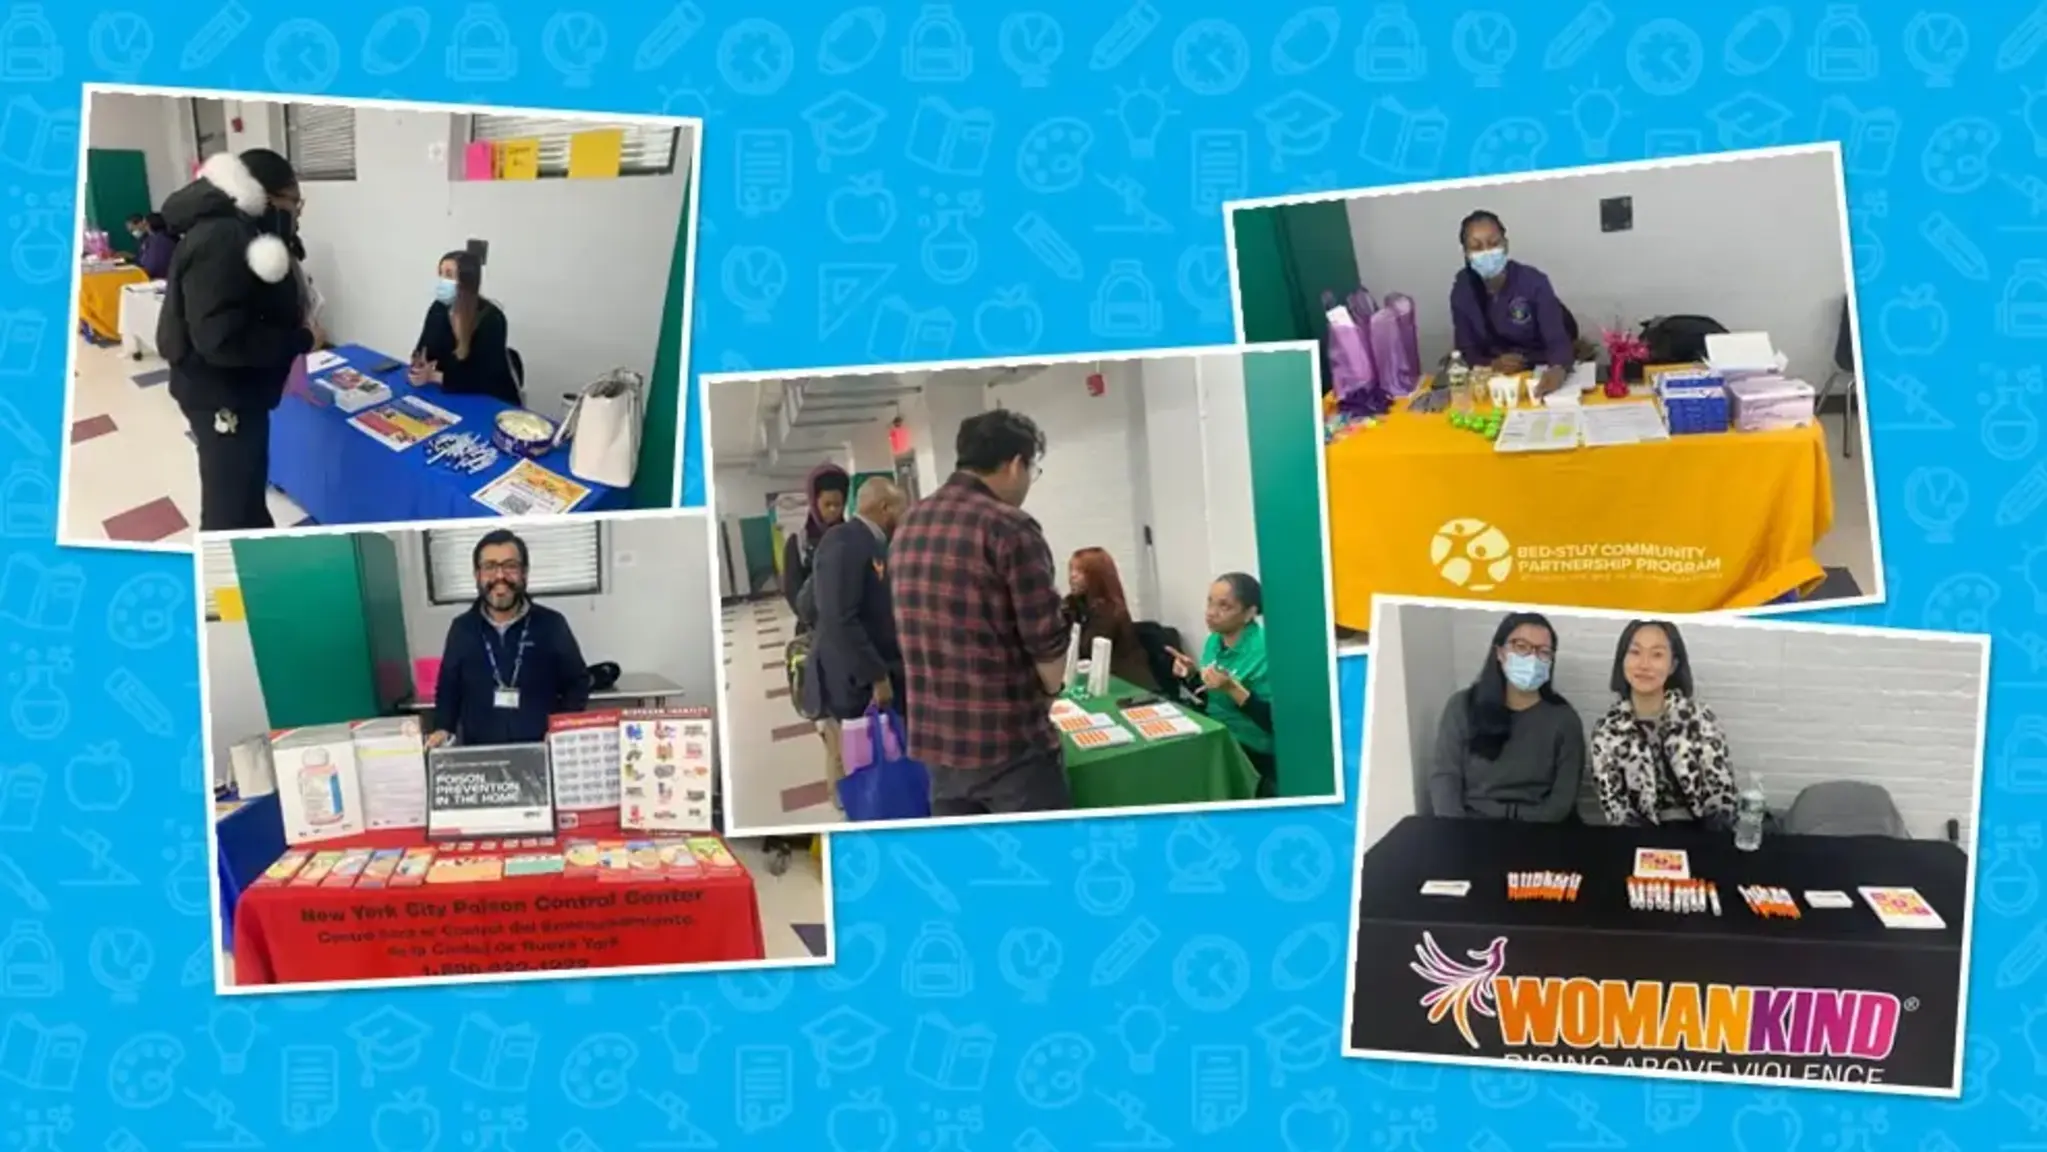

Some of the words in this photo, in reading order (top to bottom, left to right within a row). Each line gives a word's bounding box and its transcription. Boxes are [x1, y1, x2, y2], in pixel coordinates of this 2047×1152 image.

[1517, 544, 1598, 558] BED-STUY
[1601, 542, 1706, 559] COMMUNITY
[1518, 558, 1631, 572] PARTNERSHIP
[1636, 557, 1721, 574] PROGRAM
[301, 908, 345, 922] New
[352, 904, 398, 921] York
[405, 901, 446, 918] City
[452, 898, 526, 915] Poison
[535, 891, 616, 911] Control
[624, 888, 703, 906] Center
[1732, 1061, 1886, 1085] VIOLENCE
